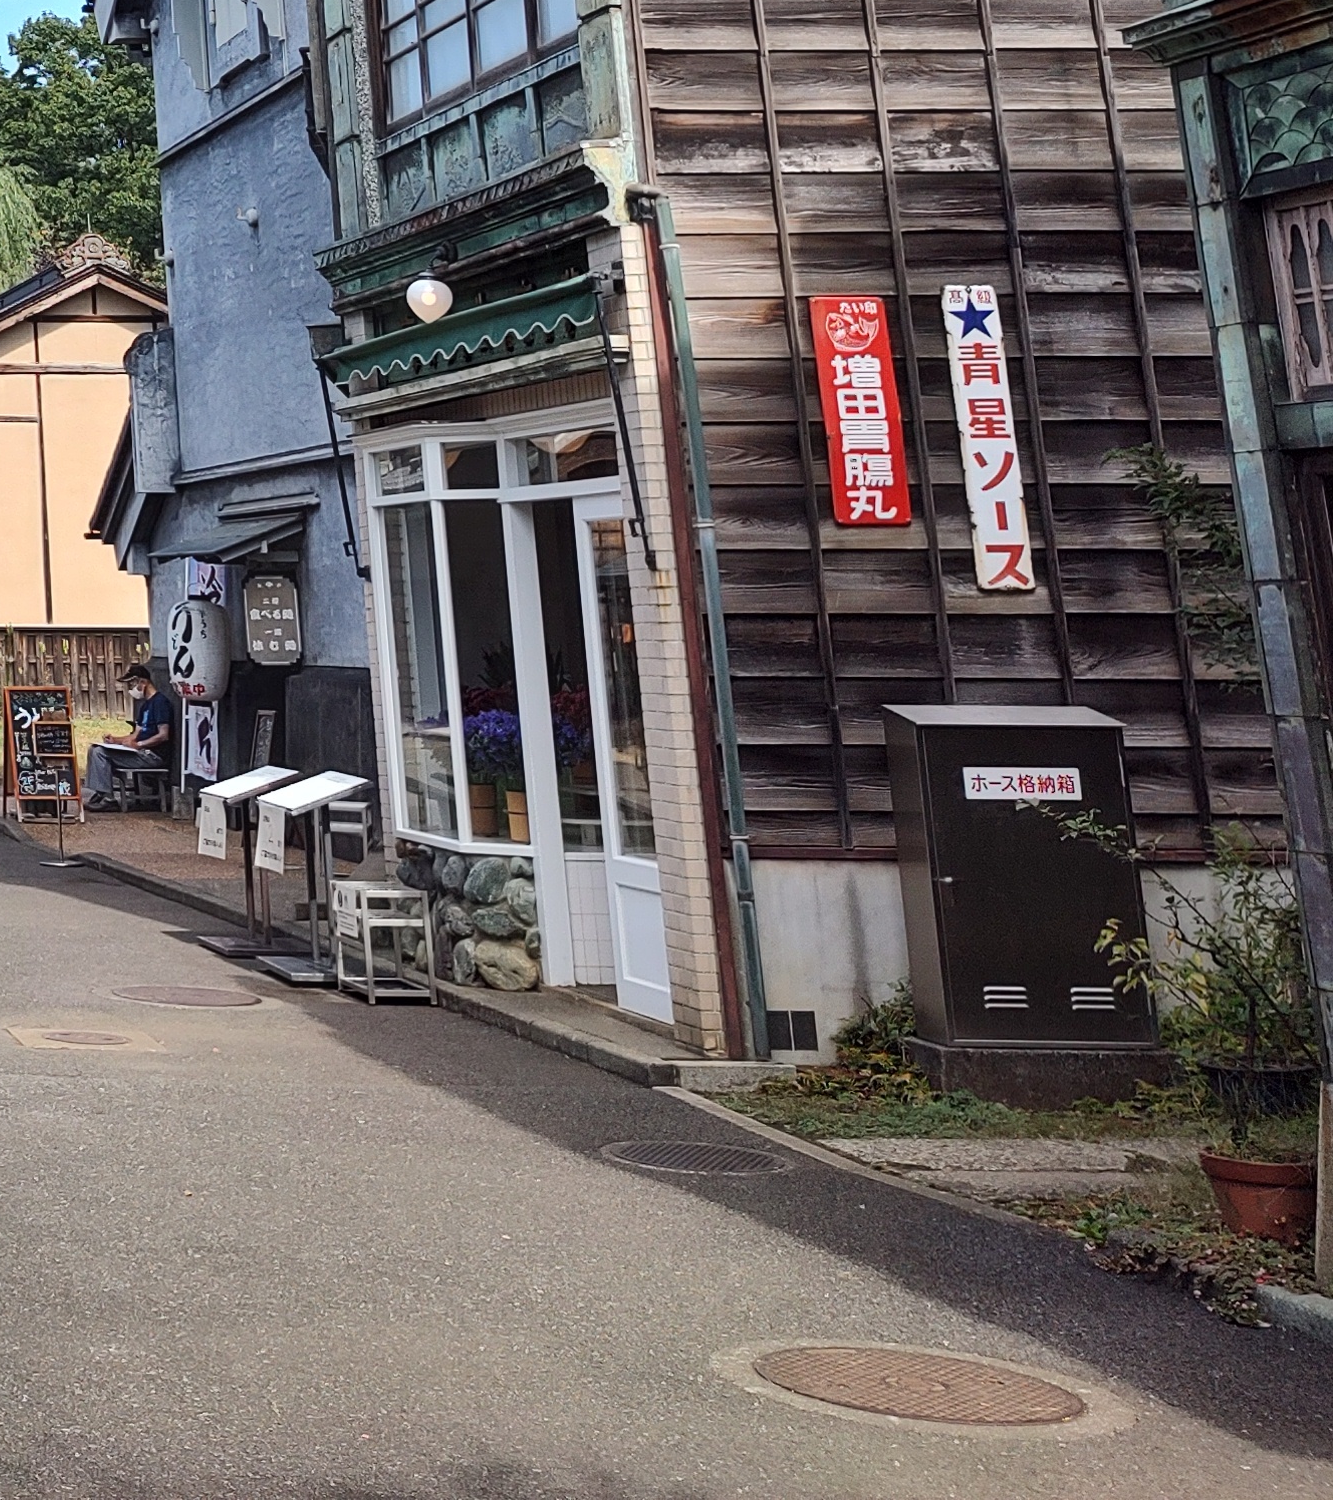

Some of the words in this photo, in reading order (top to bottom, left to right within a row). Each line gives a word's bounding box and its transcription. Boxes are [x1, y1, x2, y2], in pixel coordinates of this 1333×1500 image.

[957, 342, 1031, 587] 青星ソース
[970, 773, 1075, 795] ホース格納箱
